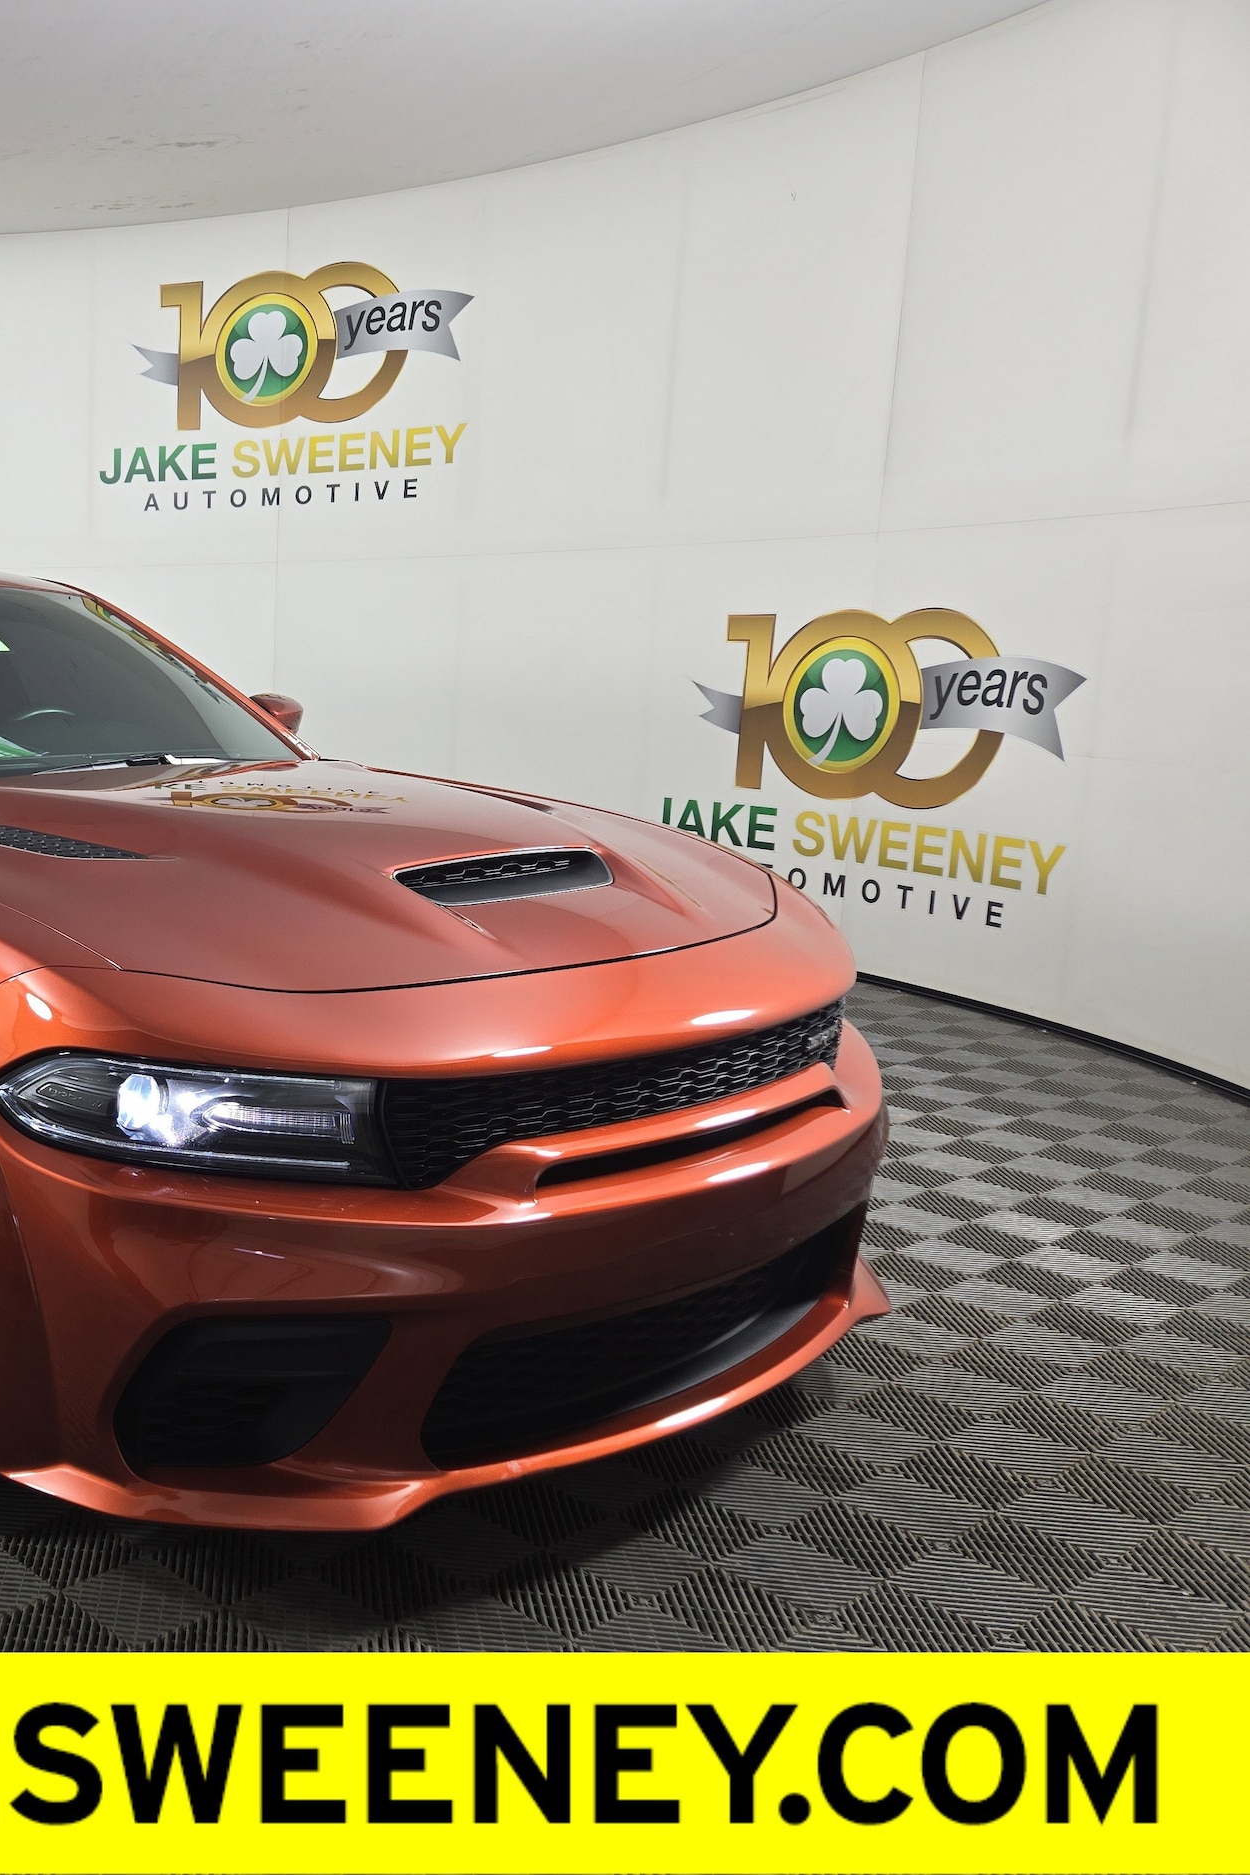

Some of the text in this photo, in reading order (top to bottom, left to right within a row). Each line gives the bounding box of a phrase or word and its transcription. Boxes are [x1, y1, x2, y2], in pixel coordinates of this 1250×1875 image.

[159, 261, 443, 431] 100 years
[99, 422, 468, 485] JAKE SWEENEY
[143, 478, 418, 512] AUTOMOTIVE
[726, 607, 1049, 810] 100 years
[791, 810, 1067, 895] SWEENEY
[759, 863, 1005, 928] OMOTIVE
